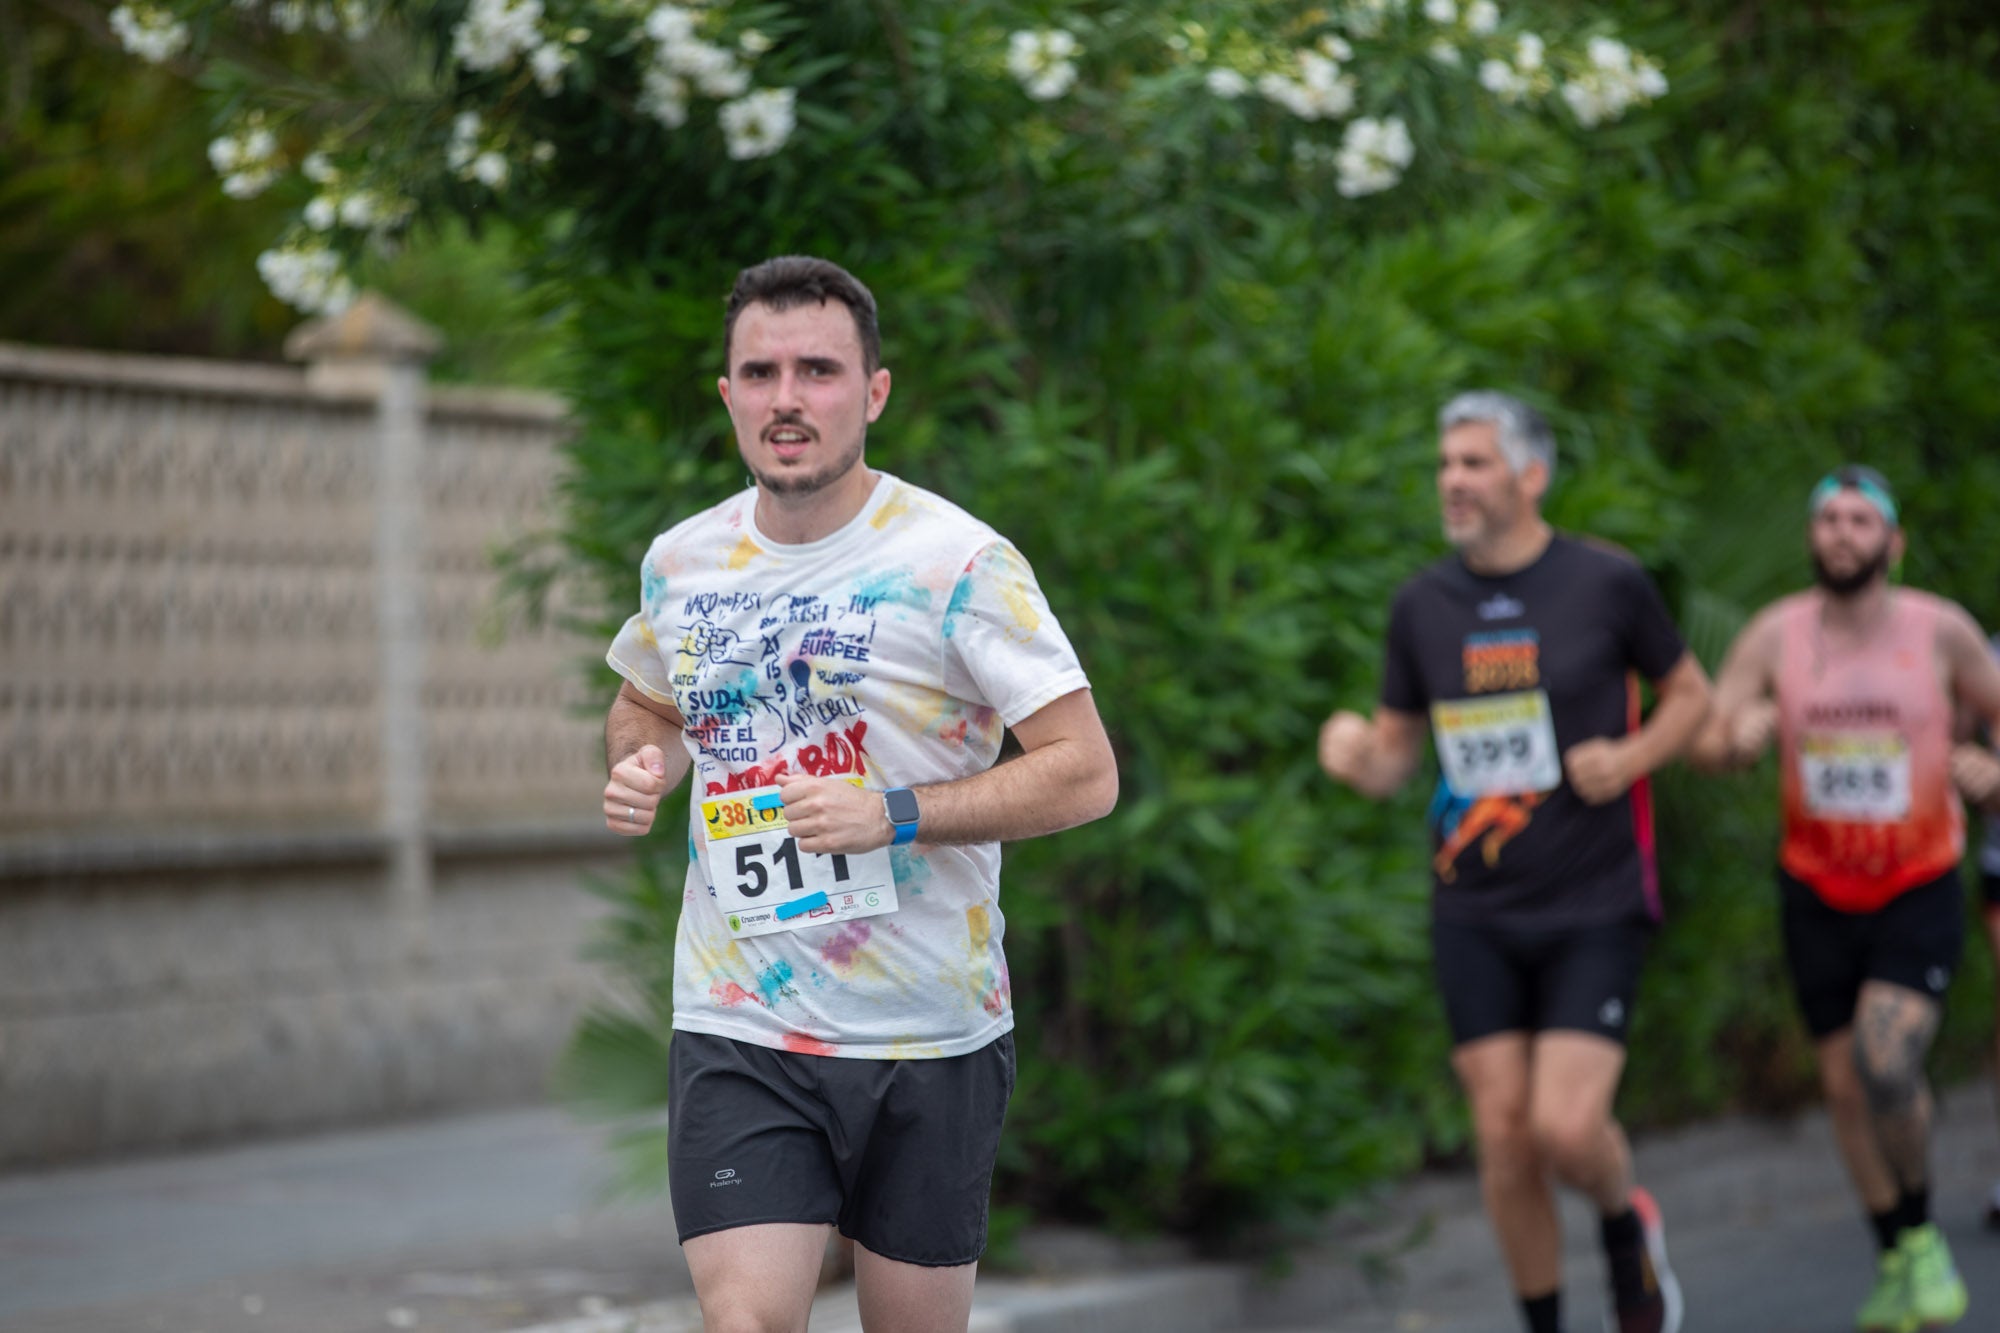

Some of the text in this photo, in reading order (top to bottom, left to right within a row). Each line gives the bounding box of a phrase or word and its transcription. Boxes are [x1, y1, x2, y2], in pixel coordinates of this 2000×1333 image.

[798, 640, 870, 662] BURPEE
[688, 689, 746, 711] SUDA
[774, 683, 787, 702] 9
[737, 726, 757, 743] EL
[797, 719, 868, 778] BOX
[721, 802, 748, 828] 38
[736, 837, 850, 898] 511
[741, 913, 771, 924] Cruzcampo
